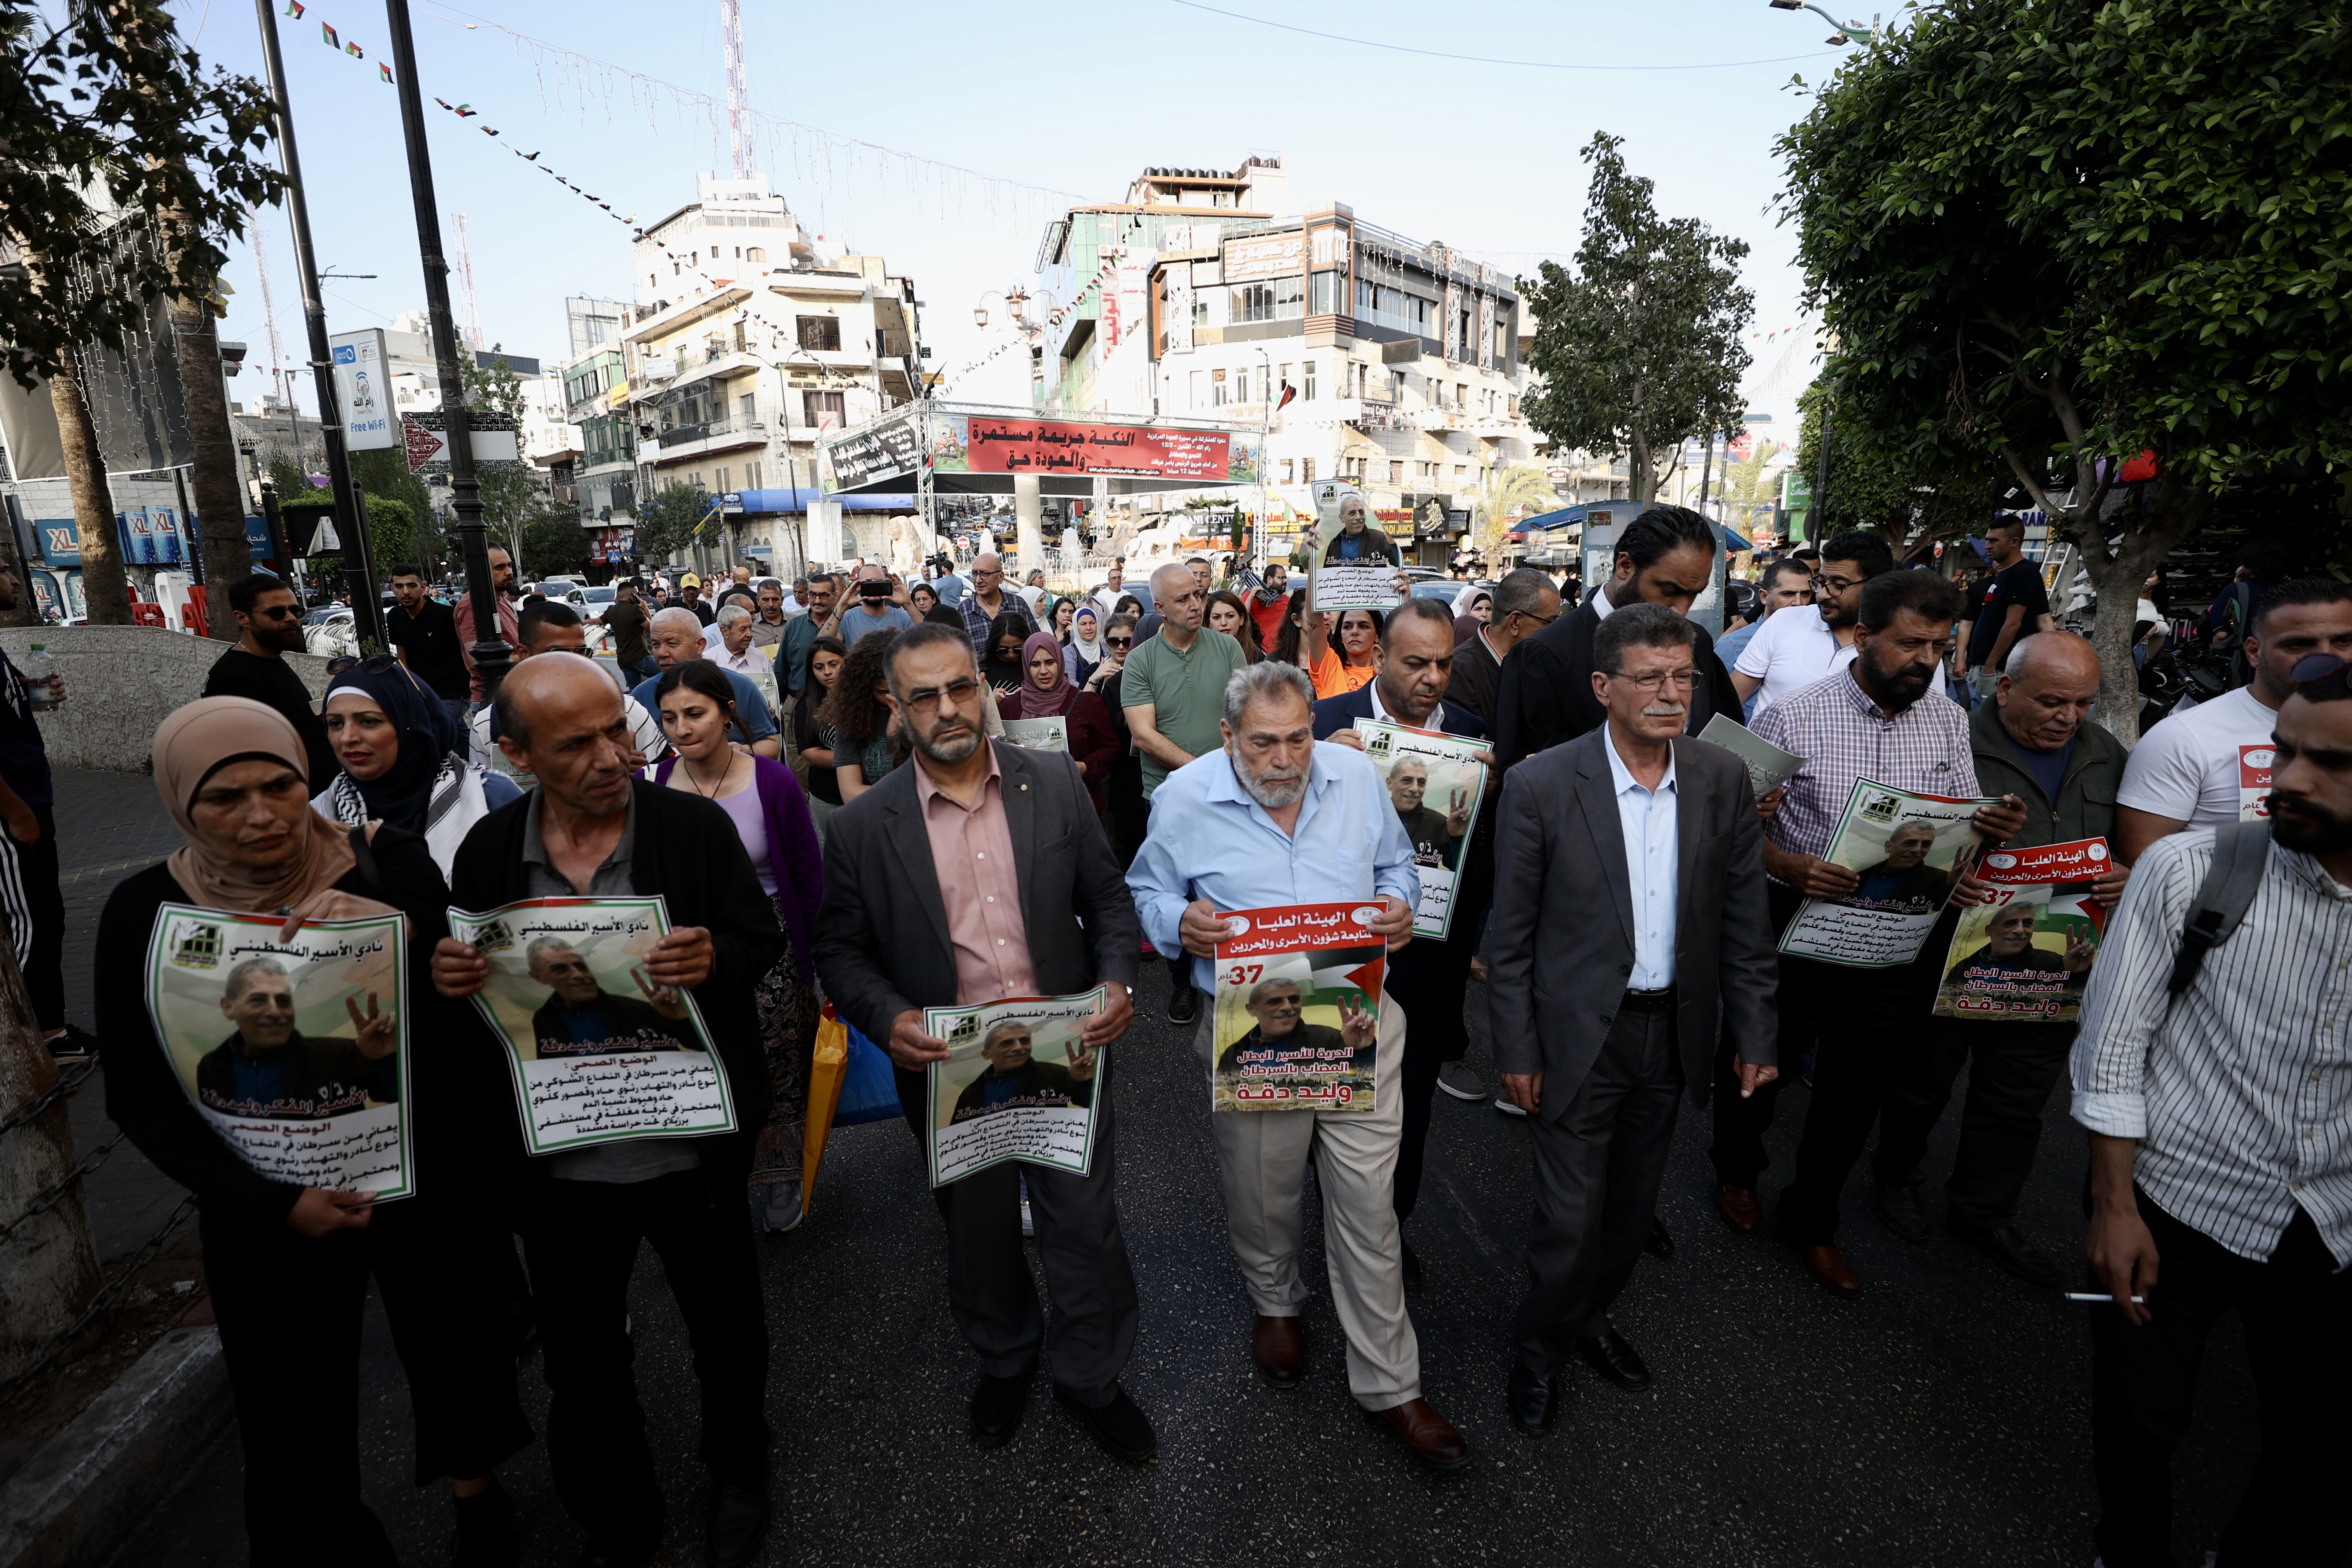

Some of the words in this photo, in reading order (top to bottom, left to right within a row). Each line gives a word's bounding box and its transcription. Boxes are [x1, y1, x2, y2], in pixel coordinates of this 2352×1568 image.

[354, 396, 363, 407] الله
[365, 396, 374, 408] رام
[1362, 404, 1375, 417] Daraj
[1376, 406, 1386, 415] Cafe
[350, 422, 366, 432] Free
[368, 419, 385, 430] Wi-Fi
[973, 424, 1032, 444] مستمرة
[1038, 426, 1084, 447] جريمة
[1089, 430, 1135, 449] النكبة
[1007, 450, 1031, 469] حق
[1035, 451, 1085, 472] والعودة
[152, 513, 174, 532] XL
[1398, 511, 1412, 521] عصير
[130, 518, 150, 535] XL
[1396, 524, 1414, 534] JUICE
[46, 528, 79, 551] XL
[1326, 556, 1336, 564] دقة
[1352, 557, 1369, 565] المفكر
[1370, 555, 1388, 566] الأسير
[1397, 743, 1442, 756] الفلسطيني
[1442, 749, 1462, 760] الأسير
[1462, 755, 1476, 766] نادي
[2243, 802, 2260, 811] عام
[2021, 854, 2055, 867] العليا
[2057, 850, 2085, 864] الهيئة
[2032, 869, 2060, 880] الأسرى
[2062, 867, 2082, 878] شؤون
[2083, 865, 2104, 875] لمتابعة
[1990, 873, 2030, 881] والمحررين
[1980, 888, 2015, 906] 37
[591, 916, 624, 934] الأسير
[1256, 915, 1301, 932] العليا
[1303, 912, 1345, 927] الهيئة
[518, 920, 589, 940] الفلسطيني
[626, 919, 648, 937] نادي
[1276, 933, 1310, 948] الأسرى
[1313, 934, 1339, 944] شؤون
[1341, 930, 1372, 943] لمتابعة
[229, 940, 309, 959] الفلسطيني
[310, 940, 352, 962] الأسير
[355, 938, 383, 962] نادي
[1229, 937, 1274, 953] والمحررين
[1218, 973, 1234, 981] عام
[1229, 965, 1264, 986] 37
[1965, 968, 1998, 977] البطل
[2000, 970, 2036, 980] للأسير
[2037, 971, 2070, 981] الحرية
[1965, 980, 2018, 992] بالسرطان
[2020, 983, 2063, 992] المصاب
[1957, 996, 2006, 1012] دقة
[2011, 1000, 2060, 1016] وليد
[985, 1010, 1045, 1029] الفلسطيني
[1045, 1007, 1074, 1019] الأسير
[1075, 1007, 1094, 1020] نادي
[541, 1038, 566, 1052] دقة
[568, 1039, 597, 1054] وليد
[599, 1038, 637, 1052] المفكر
[640, 1034, 679, 1049] الأسير
[1237, 1050, 1274, 1063] البطل
[1276, 1048, 1314, 1061] للأسير
[1317, 1047, 1353, 1059] الحرية
[571, 1058, 616, 1072] الصحي
[619, 1055, 657, 1068] الوضع
[633, 1070, 668, 1080] سرطان
[689, 1066, 713, 1078] يعاني
[1241, 1064, 1298, 1077] بالسرطان
[1302, 1062, 1349, 1075] المصاب
[545, 1075, 583, 1088] الشوكي
[587, 1072, 620, 1084] النخاع
[623, 1072, 631, 1082] في
[529, 1081, 542, 1090] من
[640, 1082, 676, 1093] والتهاب
[679, 1080, 695, 1089] نادر
[697, 1079, 716, 1090] نوع
[561, 1089, 594, 1100] وقصور
[617, 1086, 638, 1097] رئوي
[1237, 1083, 1291, 1100] دقة
[1298, 1082, 1352, 1103] وليد
[532, 1093, 558, 1108] كلوي
[582, 1100, 599, 1110] الدم
[602, 1097, 626, 1107] نسبة
[629, 1095, 657, 1104] وهبوط
[605, 1108, 639, 1118] مغلقة
[670, 1106, 678, 1115] في
[680, 1103, 721, 1115] ومحتجز
[537, 1115, 591, 1130] مستشفى
[594, 1113, 603, 1122] في
[611, 1119, 640, 1129] حراسة
[662, 1118, 688, 1130] برزيلاي
[577, 1124, 608, 1134] مشددة
